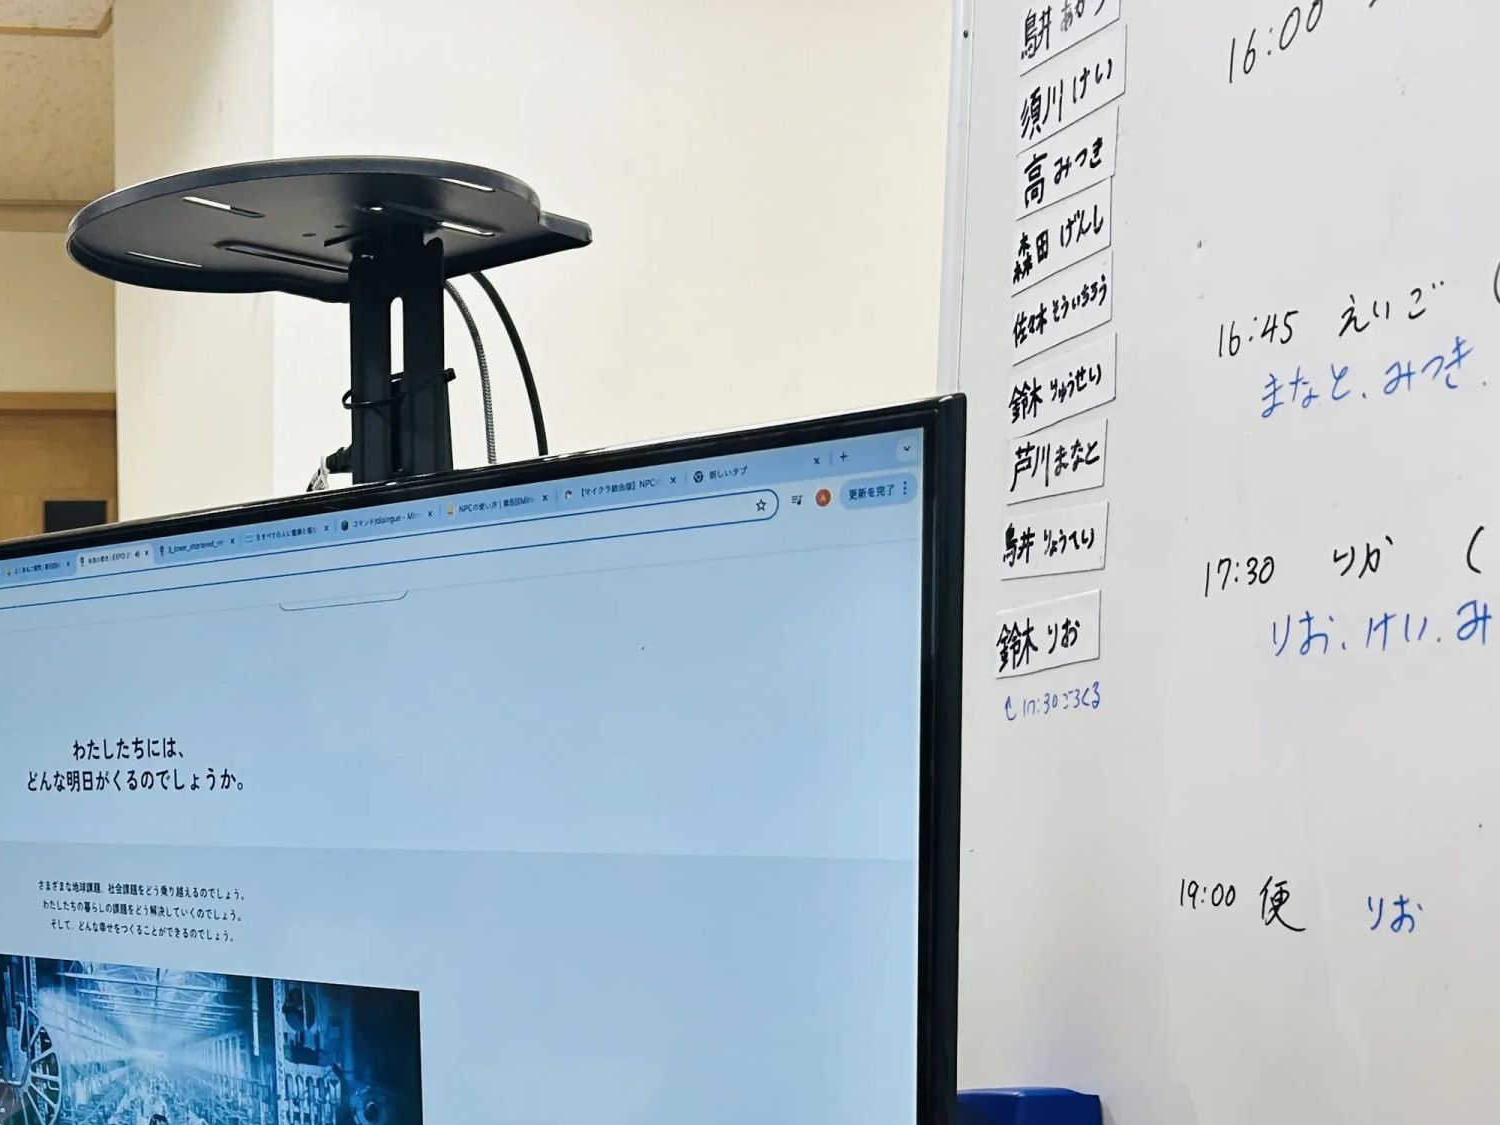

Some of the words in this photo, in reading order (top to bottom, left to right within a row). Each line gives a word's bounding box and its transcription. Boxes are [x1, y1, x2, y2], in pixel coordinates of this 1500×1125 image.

[1229, 0, 1323, 84] 16:00
[1020, 86, 1063, 140] 須川
[1073, 58, 1112, 104] けい
[1024, 152, 1048, 208] 高
[1053, 137, 1103, 185] みつき
[1012, 229, 1049, 285] 森田
[1218, 310, 1299, 358] 16:45
[1338, 280, 1445, 337] えいご
[1008, 377, 1044, 424] 鈴木
[708, 465, 749, 480] 新しいタブ
[848, 484, 896, 500] 更新を完了
[1009, 441, 1051, 492] 芦川
[1054, 438, 1100, 476] まなと
[1204, 555, 1275, 597] 17:30
[996, 616, 1039, 673] 鈴木
[1047, 617, 1081, 654] りお
[72, 736, 184, 761] わたしたちには、
[26, 767, 244, 792] どんな明日がくるのでしょうか。
[1180, 878, 1236, 909] 19:00
[1259, 875, 1306, 932] 便
[1367, 894, 1423, 933] りお
